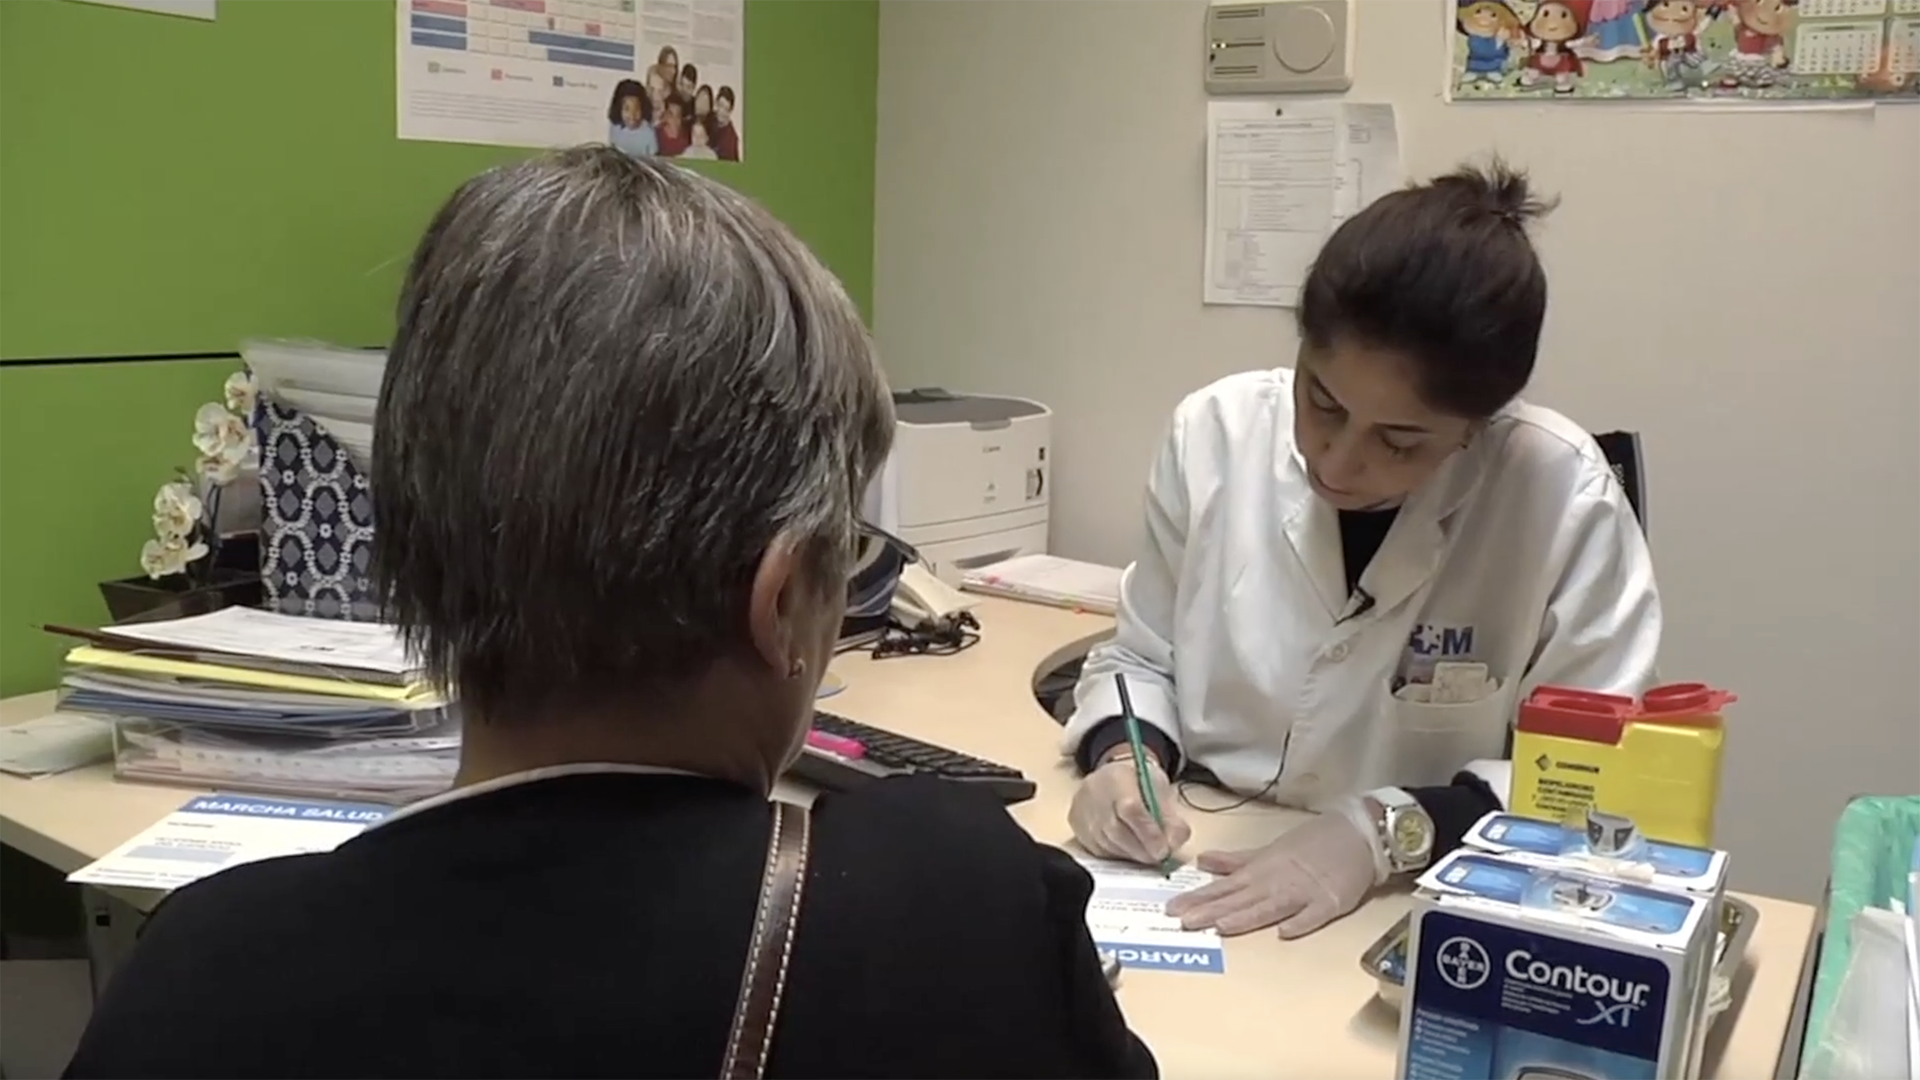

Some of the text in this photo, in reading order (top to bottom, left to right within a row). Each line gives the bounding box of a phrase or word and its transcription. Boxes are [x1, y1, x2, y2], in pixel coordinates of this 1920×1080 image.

[194, 801, 384, 820] MARCHA SALUD
[1505, 950, 1650, 1004] Contour
